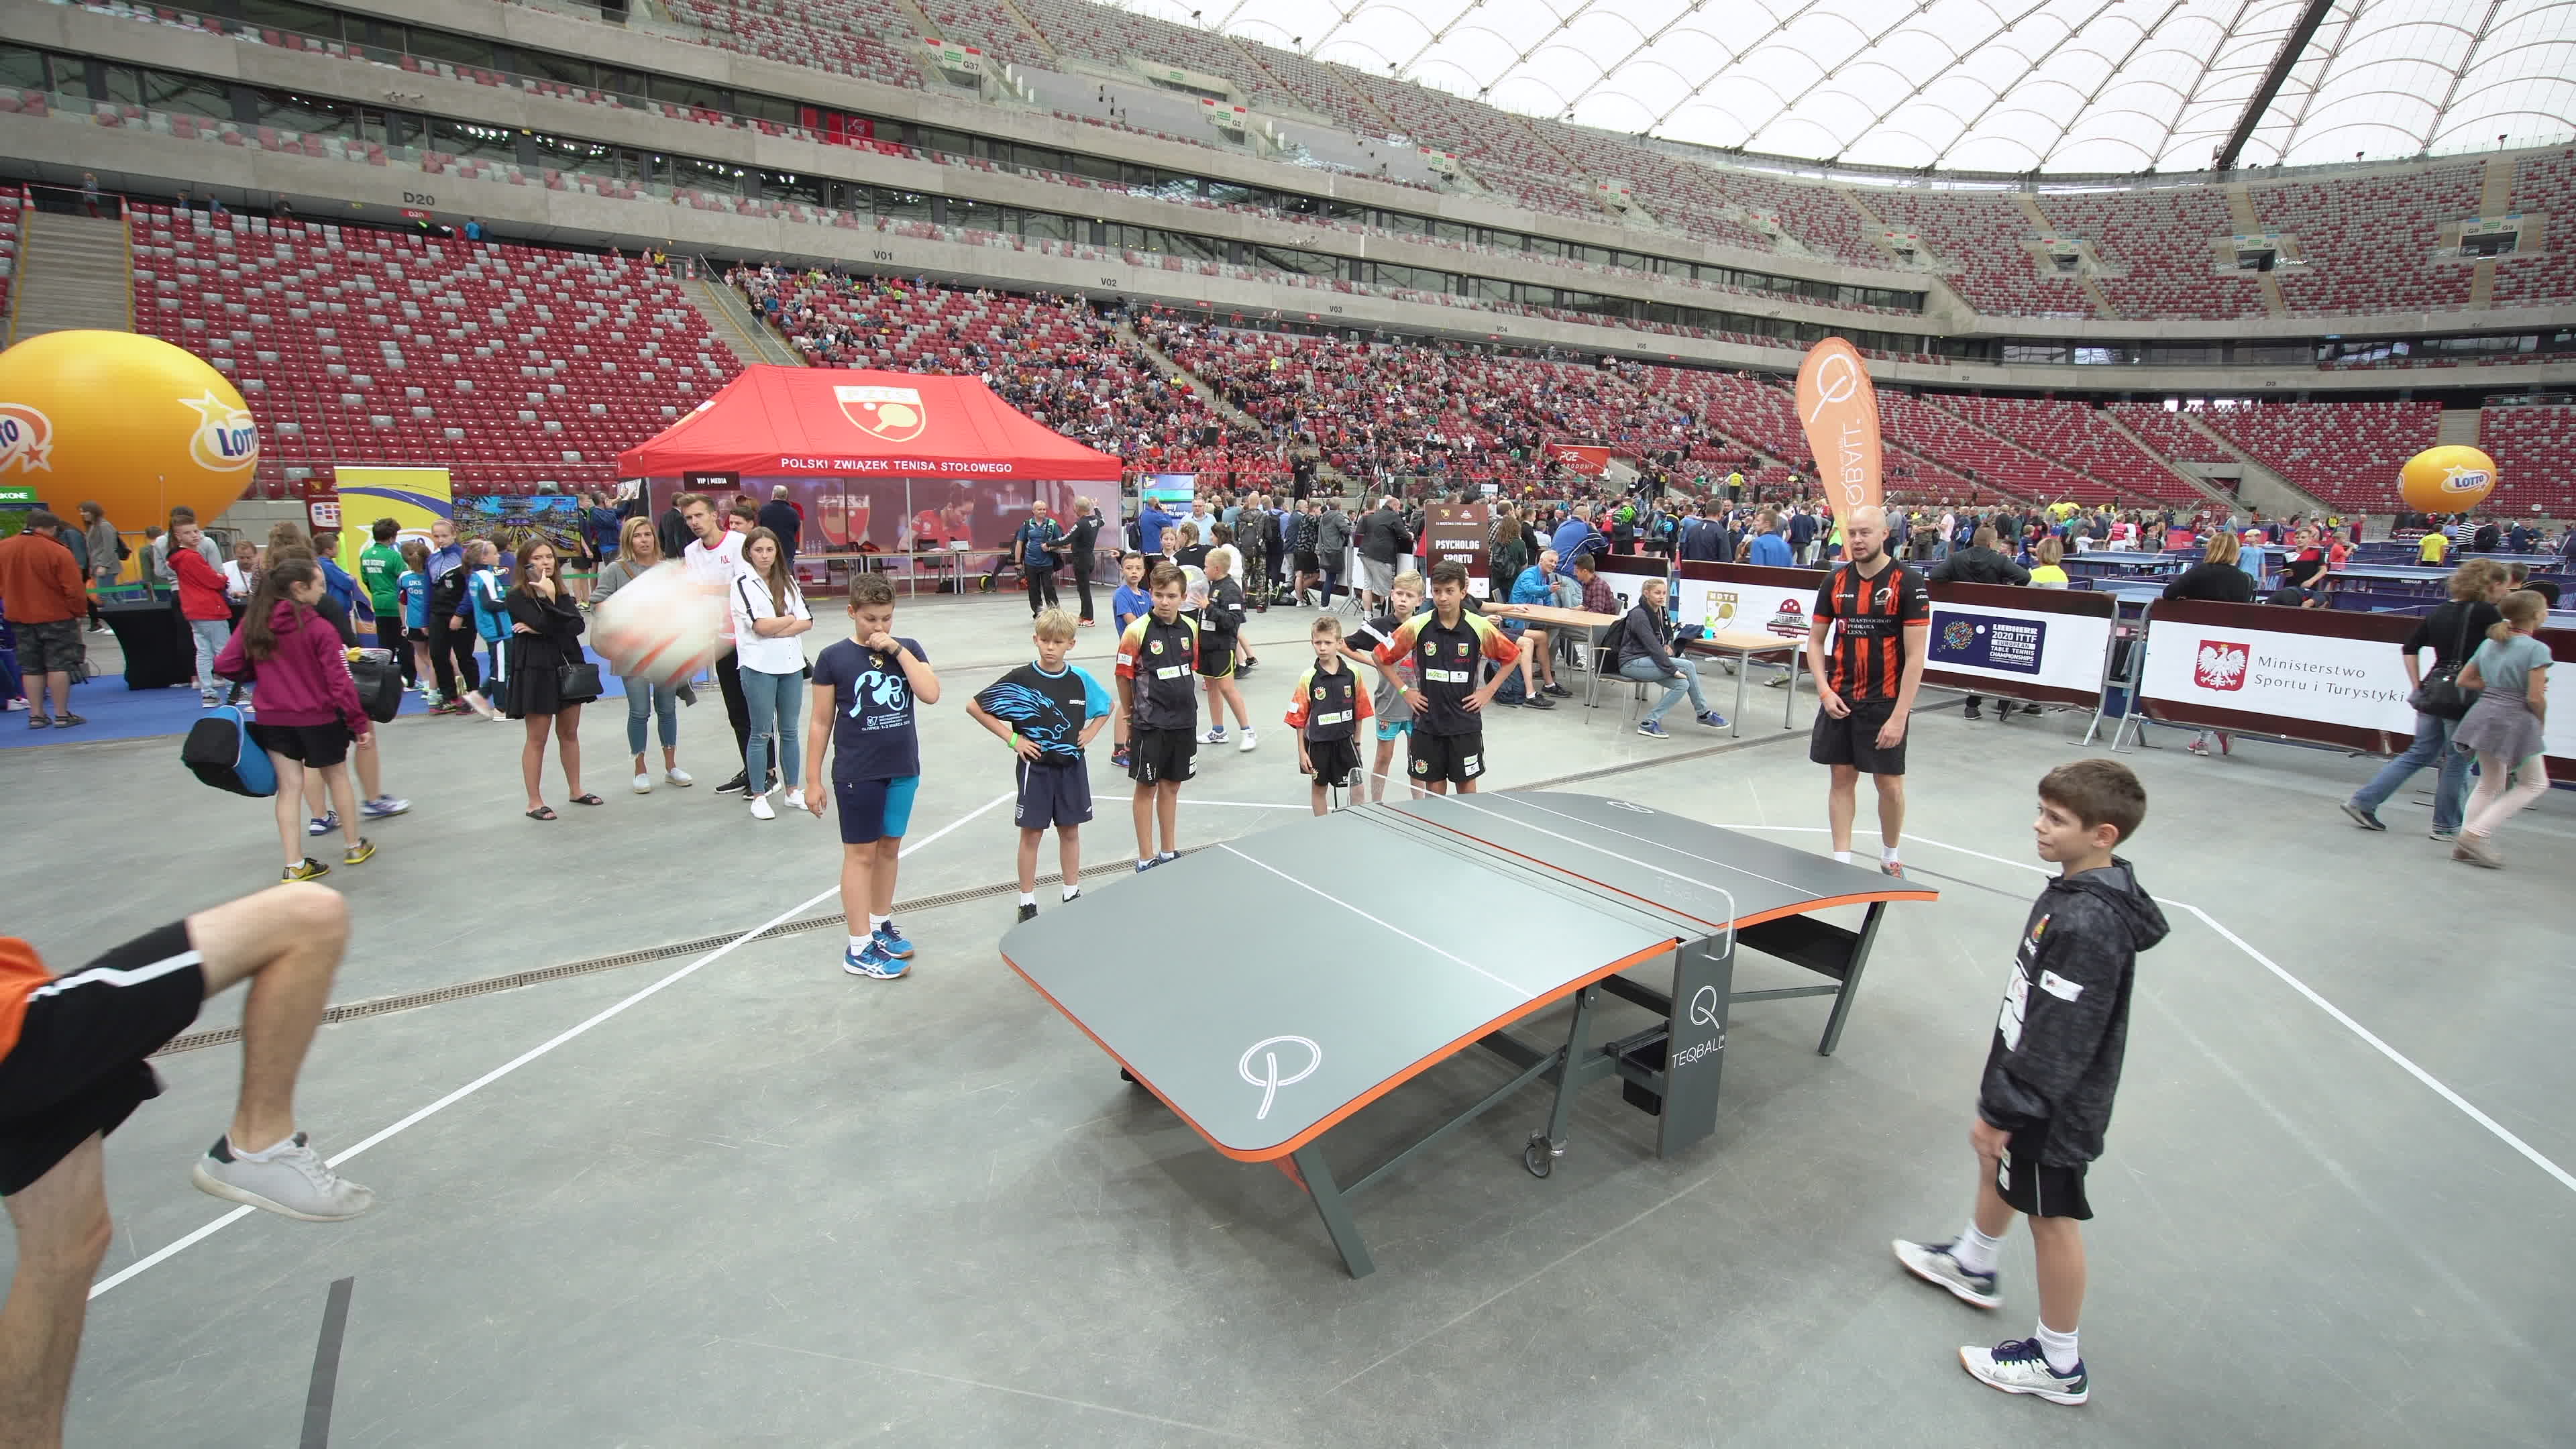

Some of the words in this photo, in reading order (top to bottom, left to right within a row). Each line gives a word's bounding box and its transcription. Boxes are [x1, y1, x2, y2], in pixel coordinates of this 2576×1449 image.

[963, 60, 979, 70] G37
[403, 192, 435, 205] D20
[873, 250, 892, 261] V01
[1101, 277, 1117, 287] V02
[1330, 305, 1342, 313] V03
[1559, 451, 1578, 462] PGE
[782, 458, 828, 469] POLSKI
[834, 460, 889, 472] ZWIĄZEK
[894, 460, 936, 471] TENISA
[941, 462, 1012, 473] STOŁOWEGO
[696, 477, 706, 485] VIP
[710, 477, 727, 485] MEDIA
[2455, 475, 2484, 488] LOTTO
[1435, 539, 1481, 549] PSYCHOLOG
[1444, 553, 1473, 564] SPORTU
[1992, 624, 2038, 635] LIEBHERR
[1992, 631, 2014, 641] 2020
[2015, 633, 2037, 643] ITTF
[1997, 640, 2030, 649] EUROPEAN
[1990, 645, 2010, 653] TABLE
[2012, 648, 2035, 656] TENNIS
[1990, 651, 2035, 662] CHAMPIONSHIPS
[2258, 655, 2365, 678] Ministerstwo
[2254, 674, 2307, 690] Sportu
[2314, 682, 2318, 692] i
[2326, 682, 2405, 702] Turystyki
